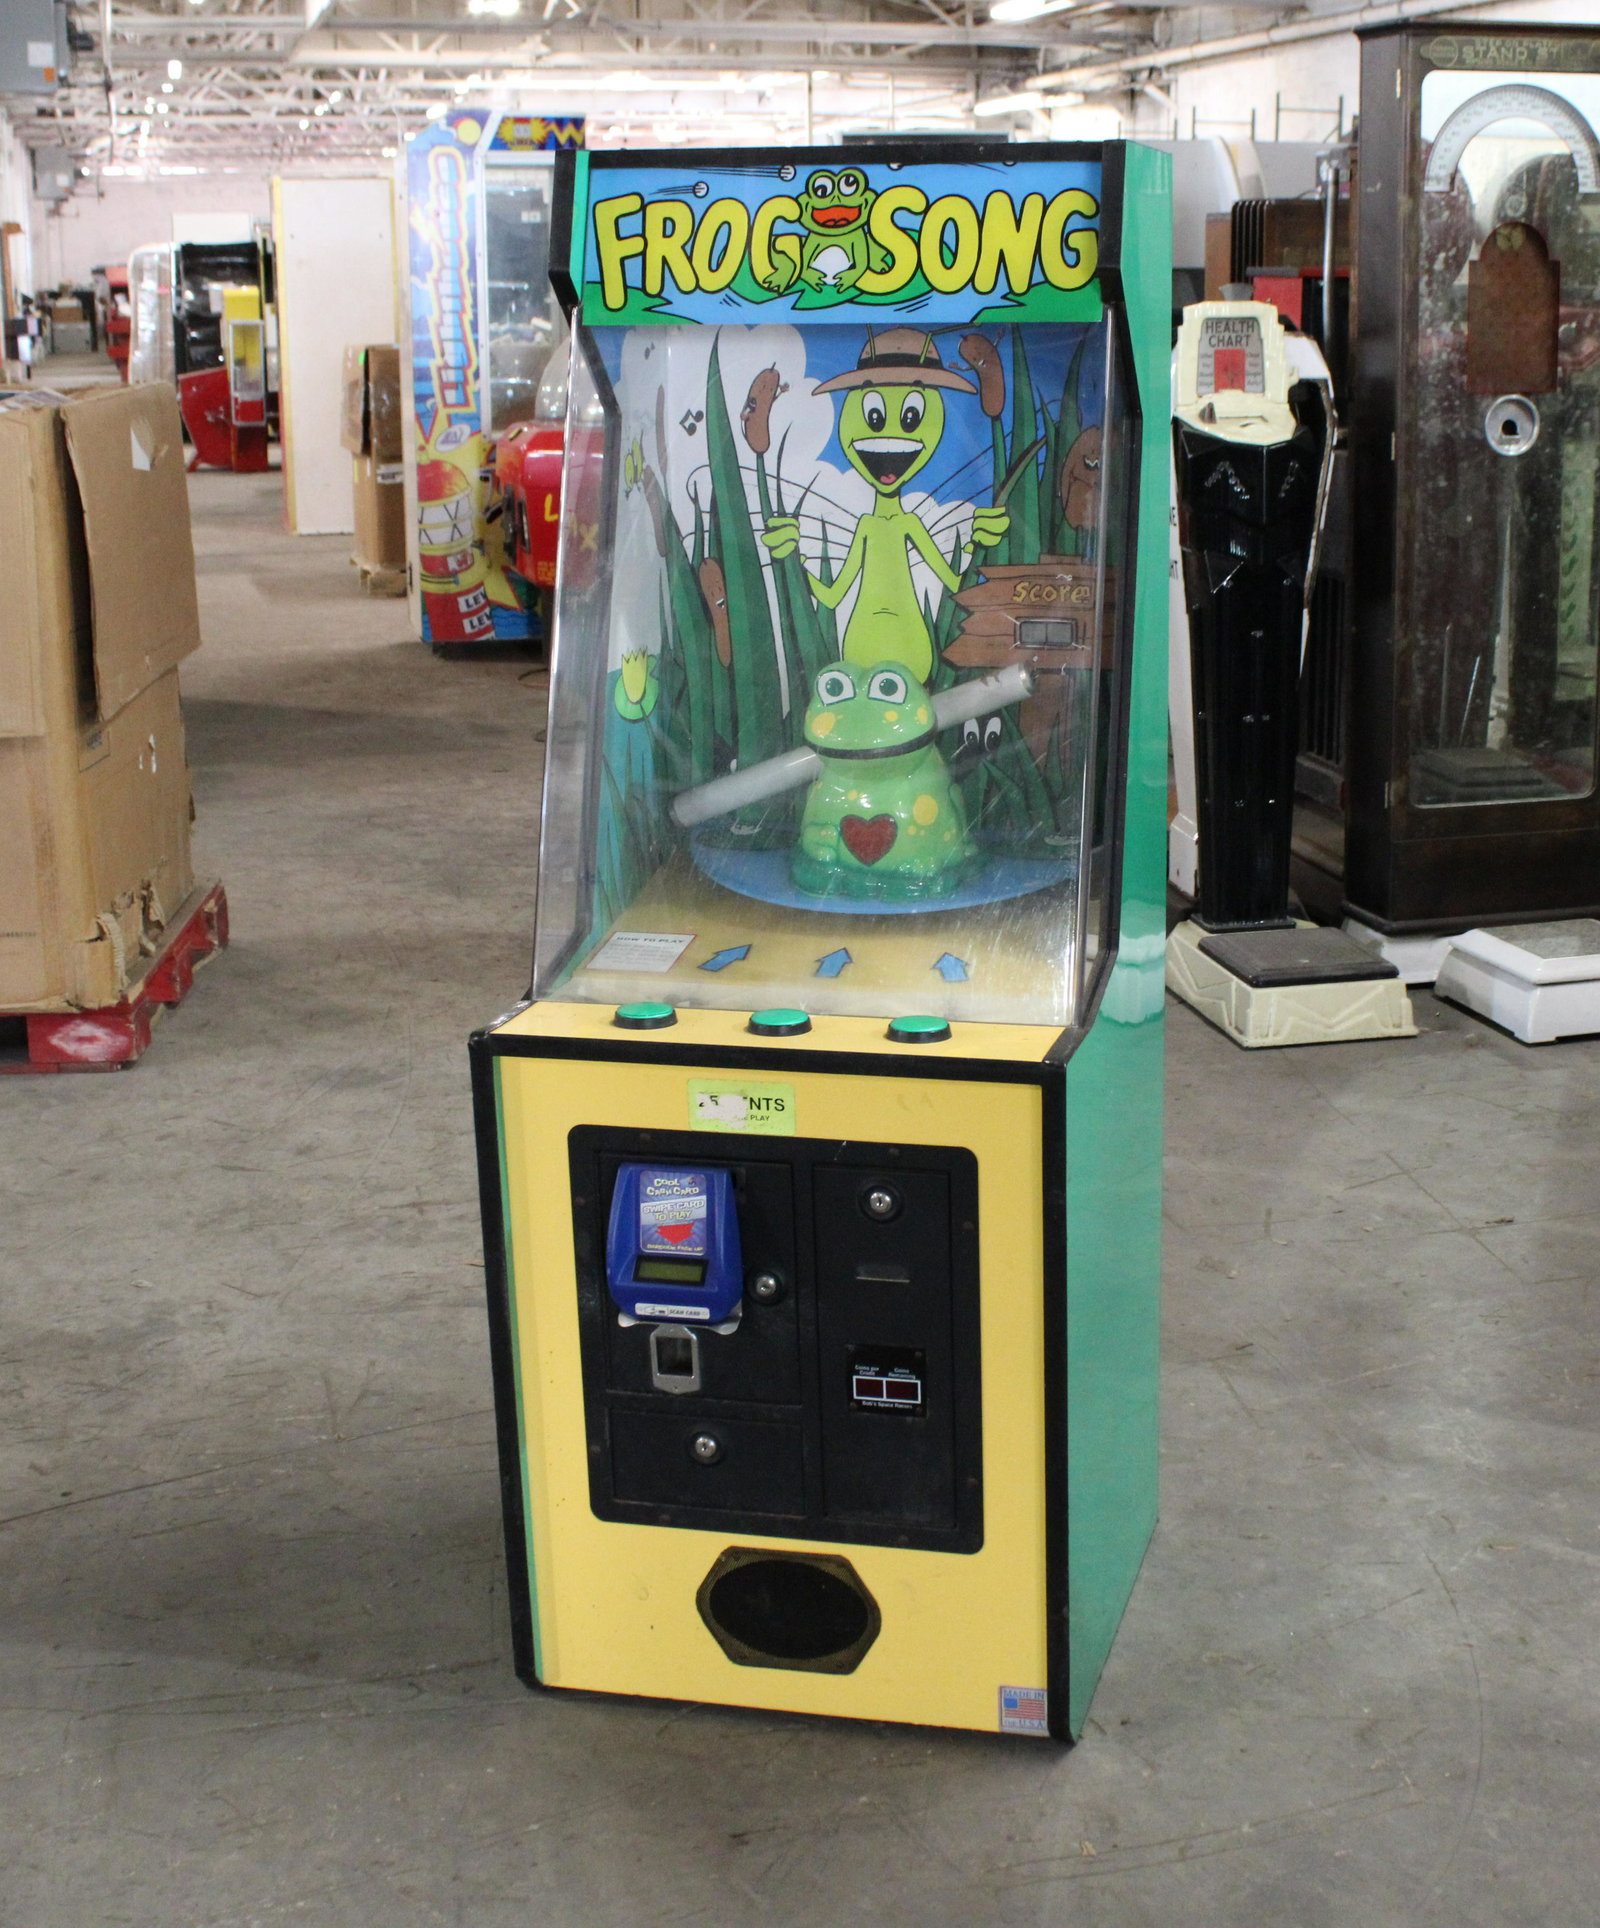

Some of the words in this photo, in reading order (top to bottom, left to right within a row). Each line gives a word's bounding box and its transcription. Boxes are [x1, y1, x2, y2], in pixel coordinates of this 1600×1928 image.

[1462, 46, 1527, 60] STAND
[594, 192, 801, 311] FROG
[856, 185, 1100, 296] SONG
[1205, 320, 1255, 334] HEALTH
[1208, 334, 1250, 348] CHART
[698, 1095, 720, 1108] 5
[742, 1095, 785, 1112] NTS
[750, 1114, 770, 1122] PLAY
[643, 1203, 675, 1214] SWIPE
[677, 1200, 705, 1210] CARD
[669, 1210, 692, 1220] PLAY
